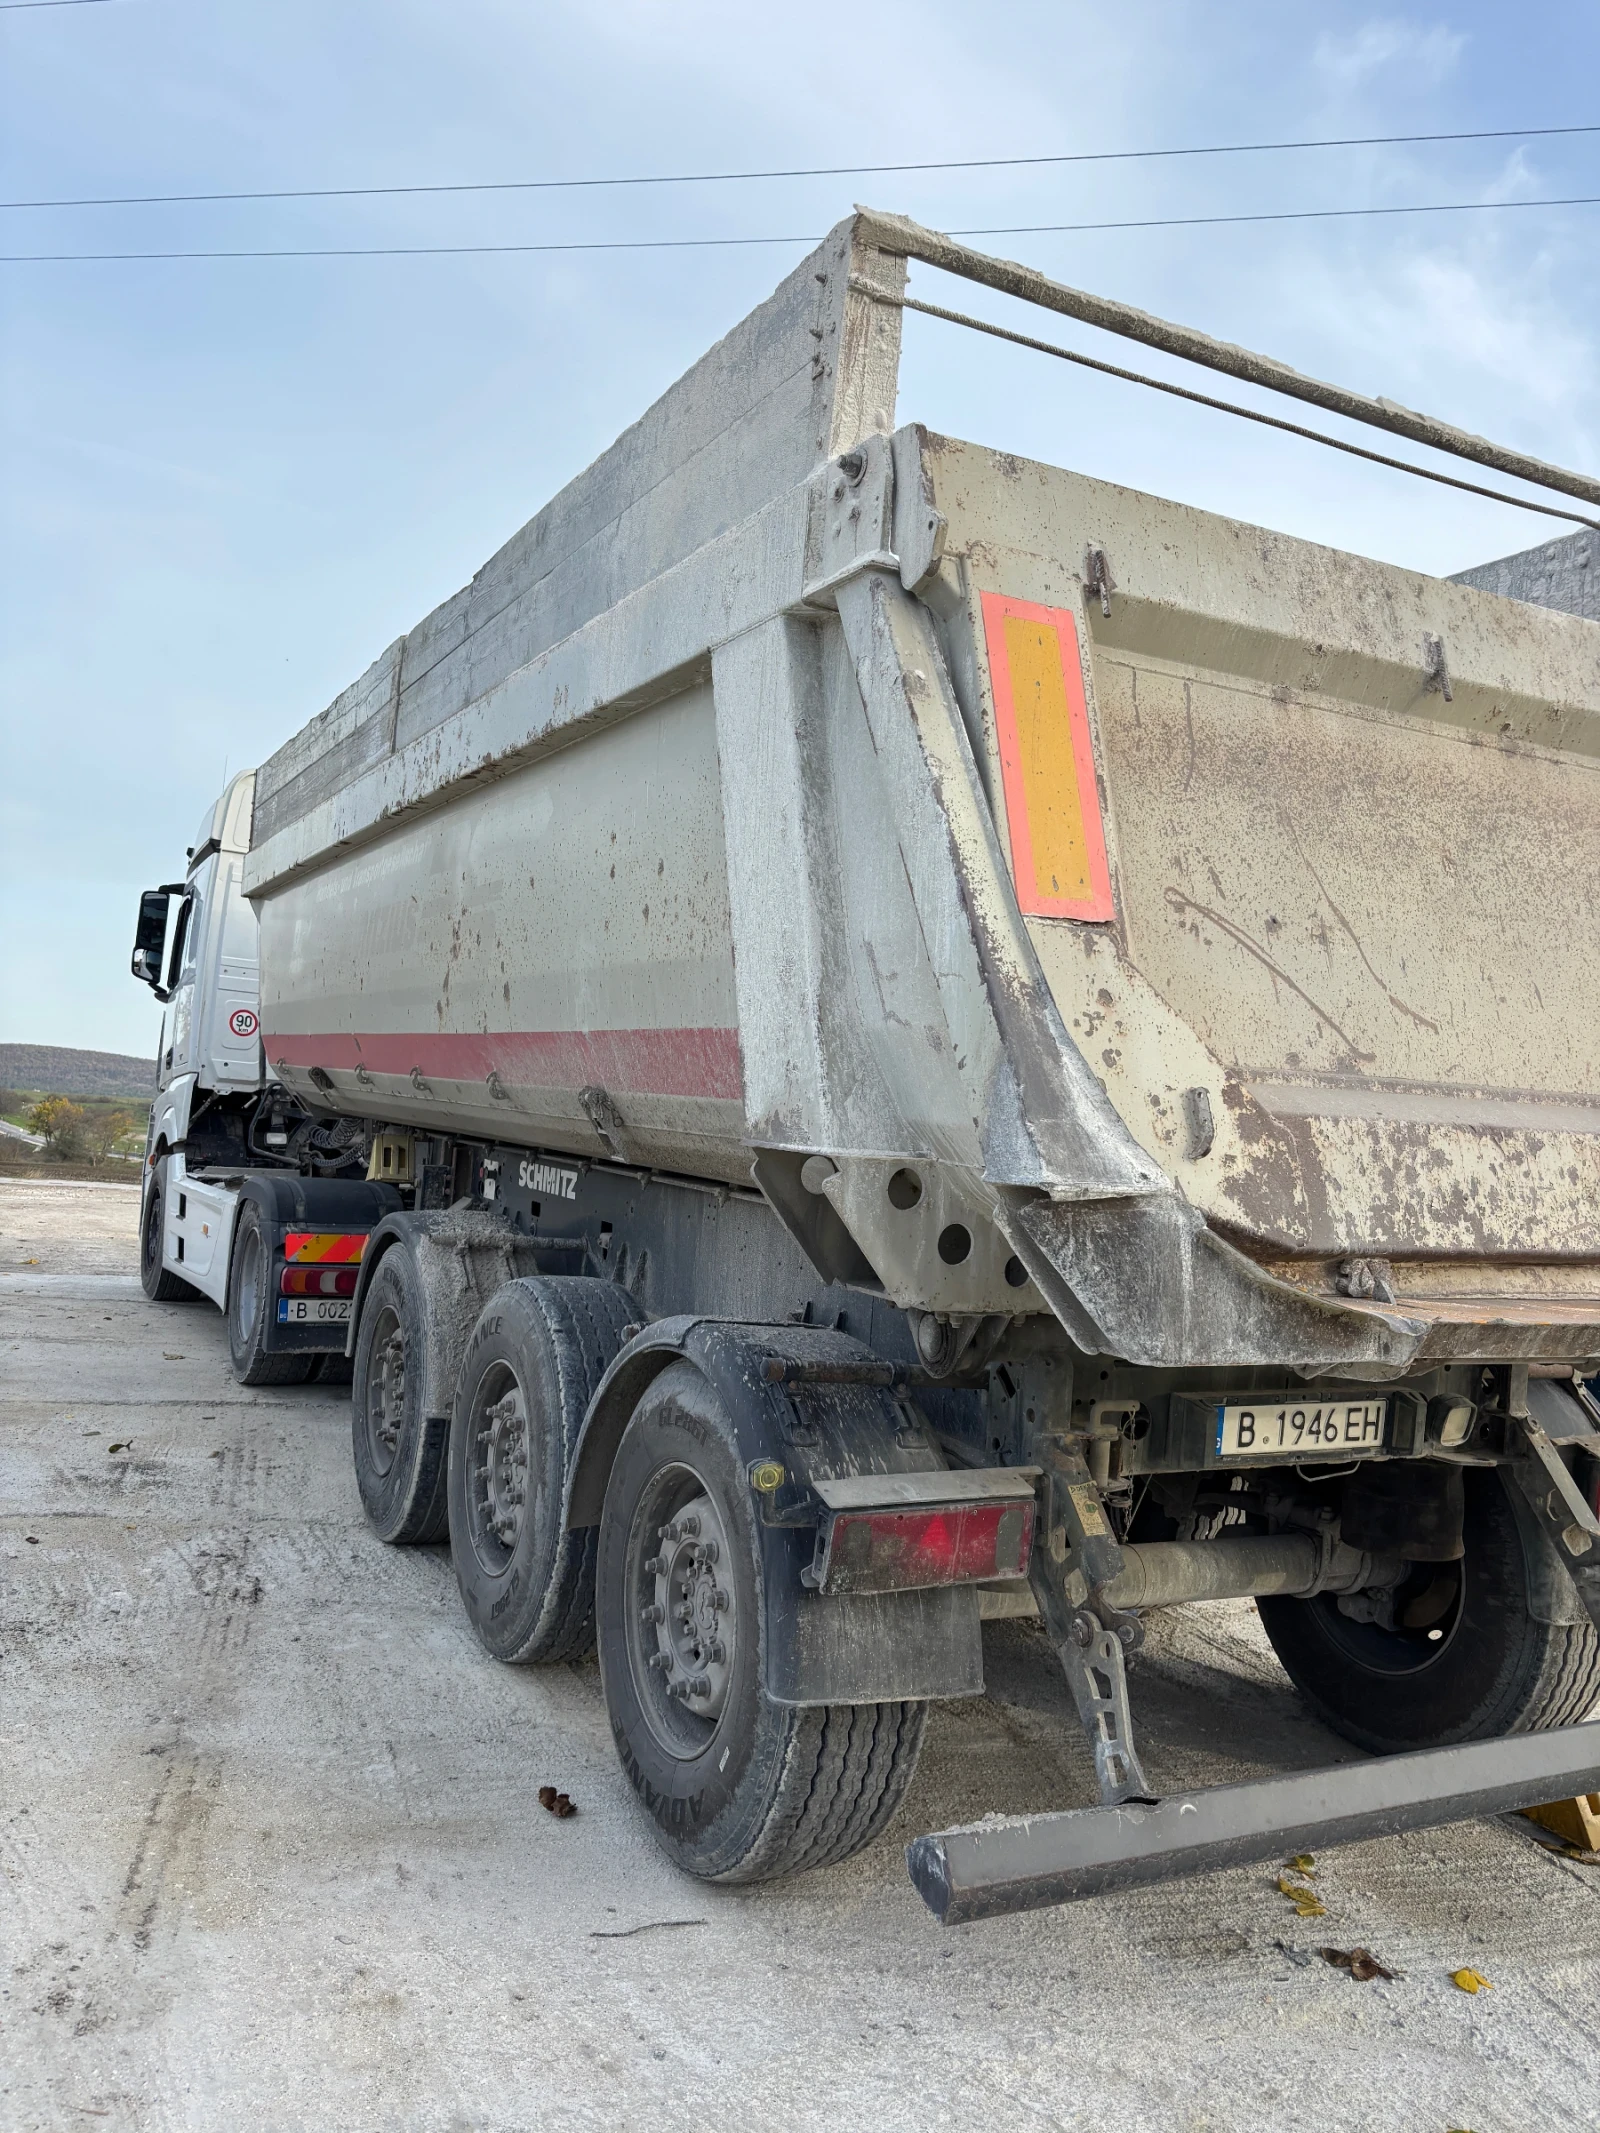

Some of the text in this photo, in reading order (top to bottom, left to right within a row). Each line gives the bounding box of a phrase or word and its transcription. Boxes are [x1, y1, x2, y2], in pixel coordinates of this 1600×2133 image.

[236, 1014, 253, 1028] 90
[518, 1161, 579, 1200] SCHMITZ
[296, 1302, 308, 1319] B
[1238, 1406, 1382, 1449] B 1946 EH
[611, 1716, 705, 1824] ADVANCE
